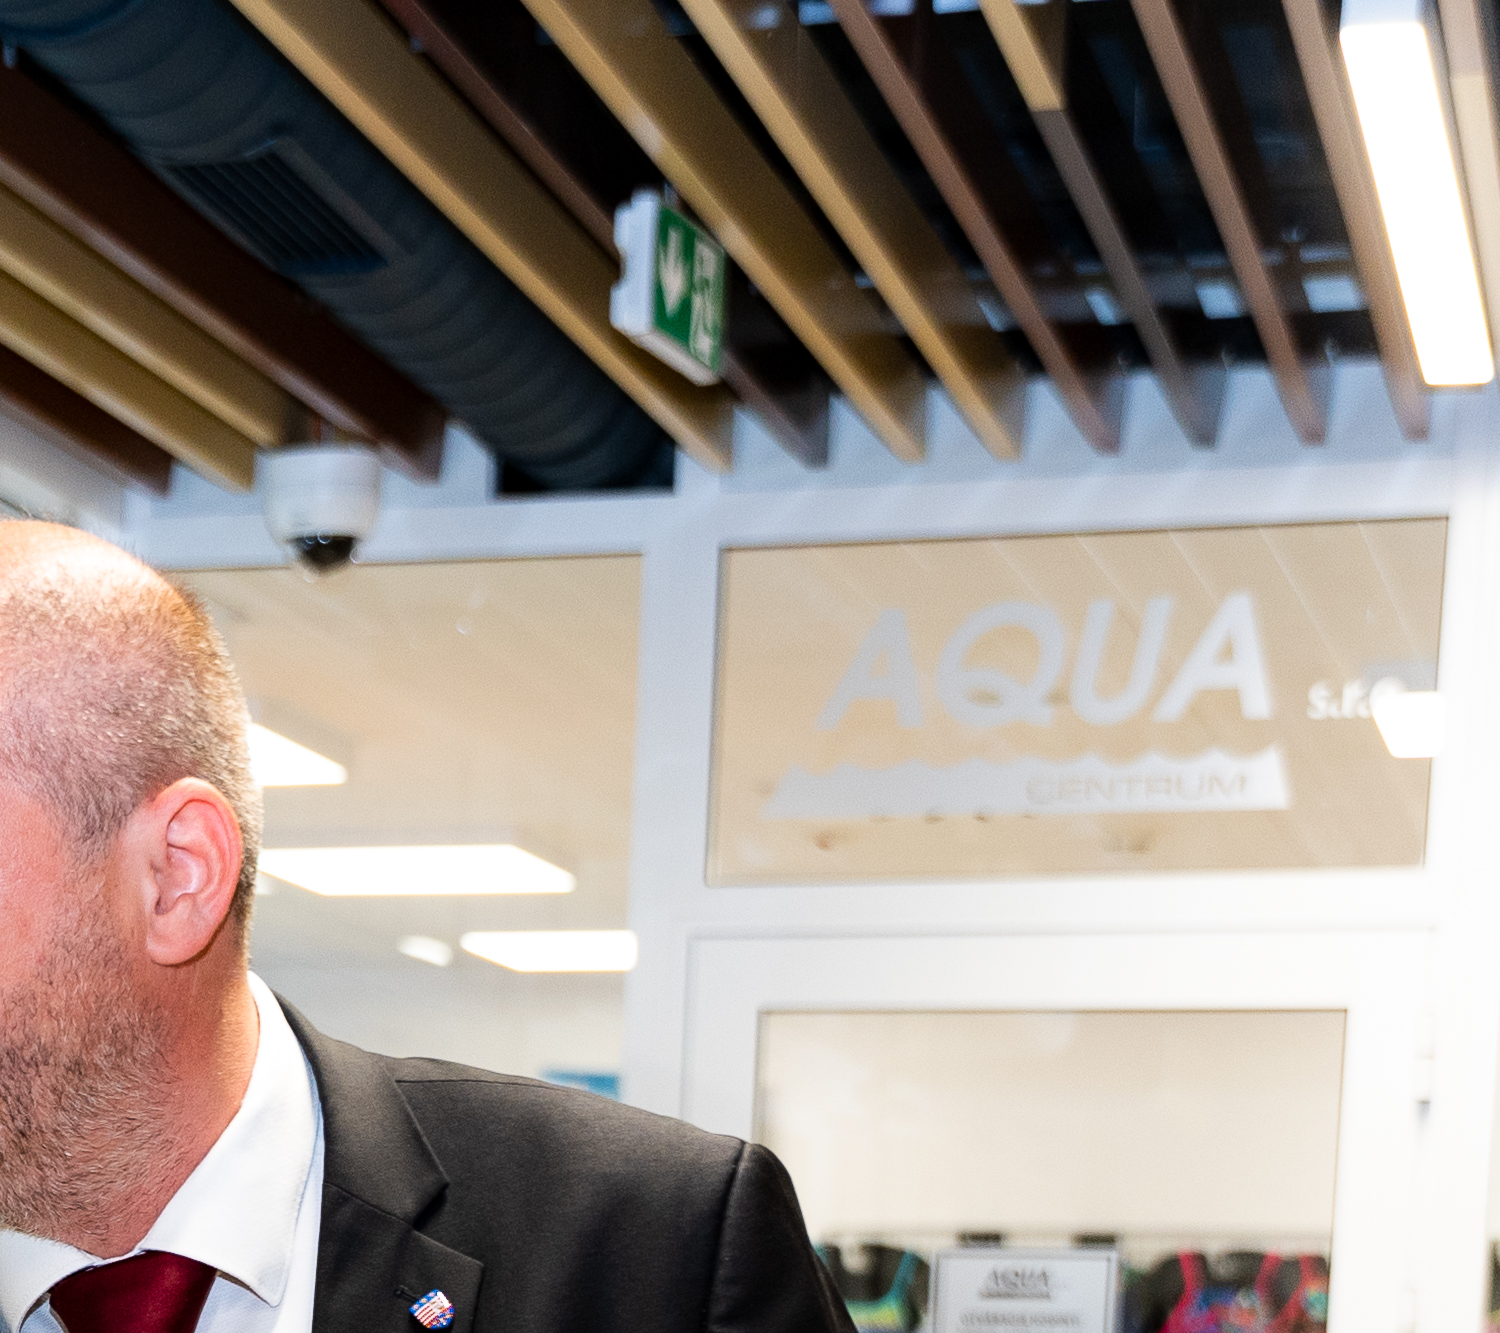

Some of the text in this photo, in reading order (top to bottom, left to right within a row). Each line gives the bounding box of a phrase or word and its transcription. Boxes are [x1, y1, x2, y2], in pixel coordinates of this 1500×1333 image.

[815, 590, 1405, 732] AQUA s.r.o
[1025, 770, 1250, 806] CENTRUM
